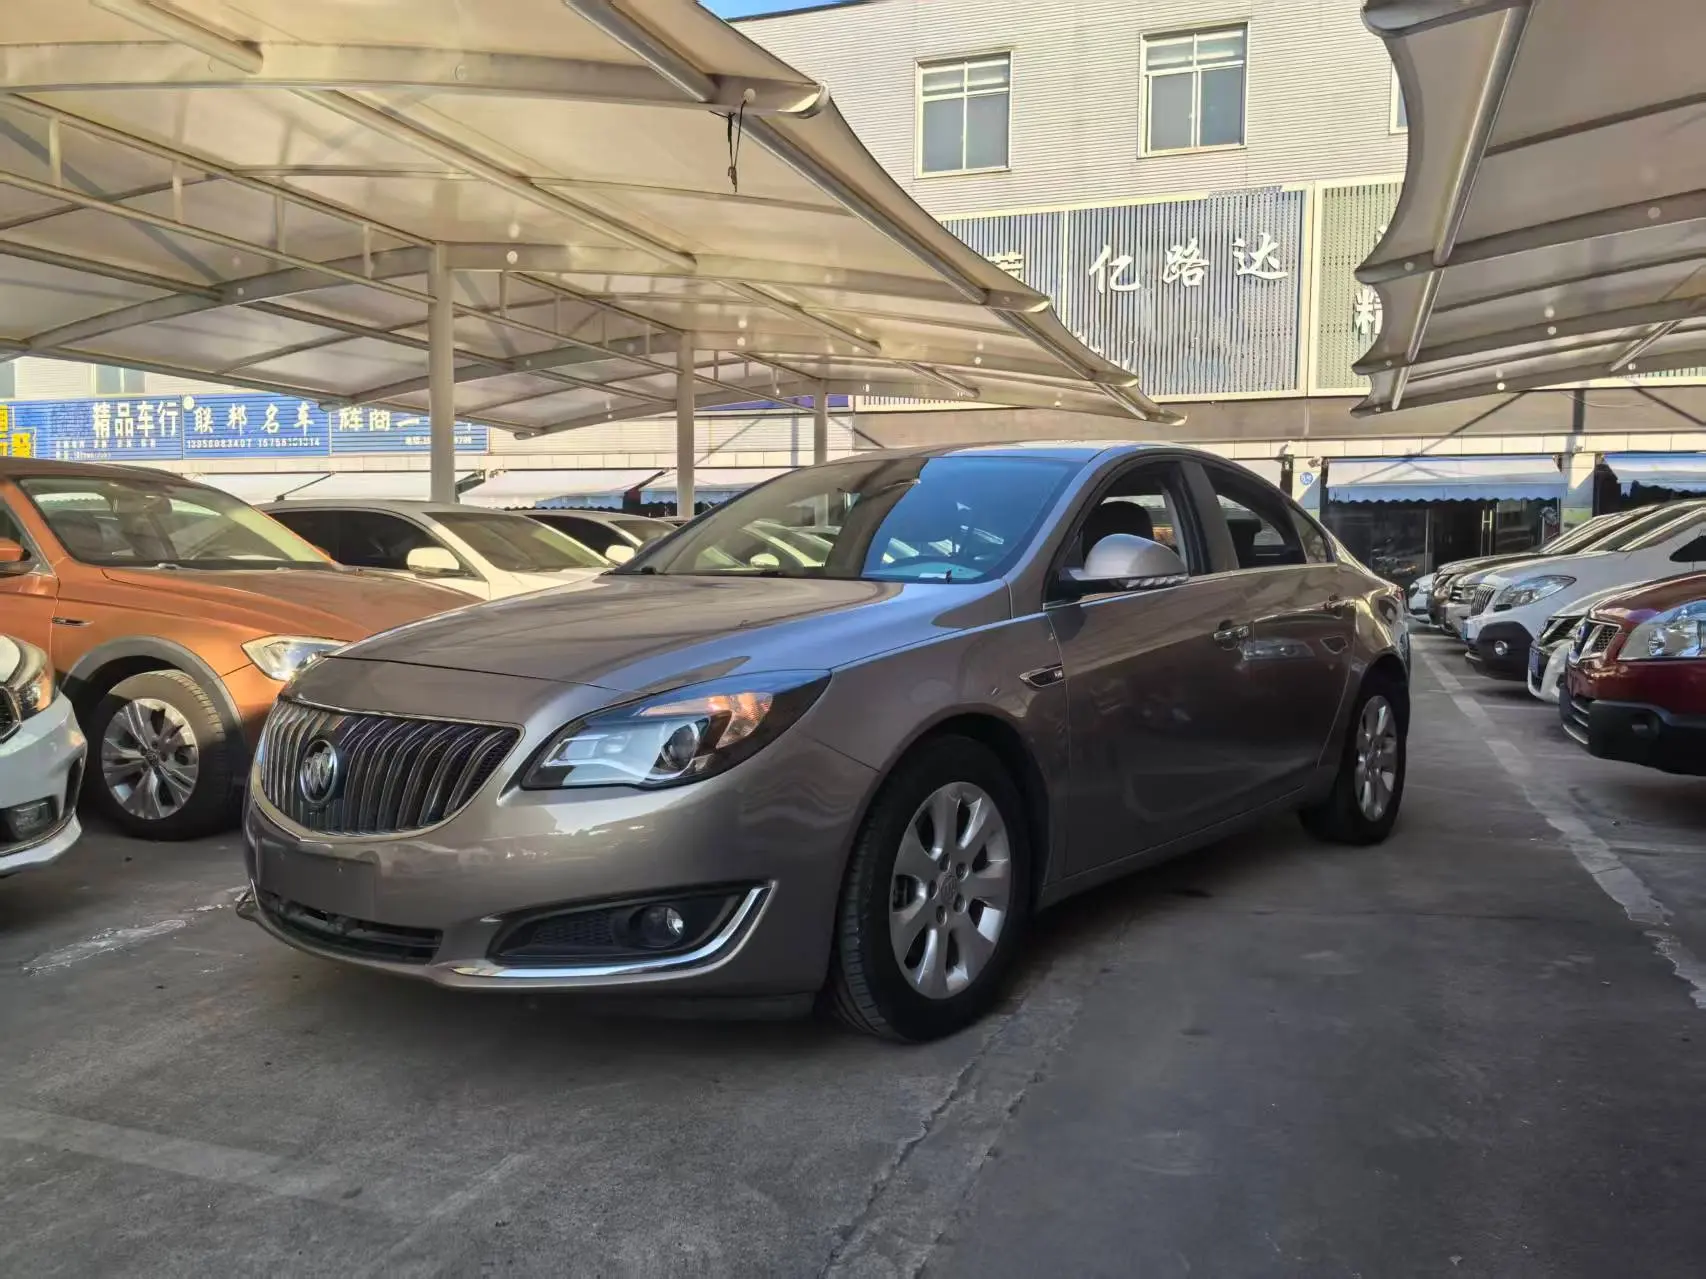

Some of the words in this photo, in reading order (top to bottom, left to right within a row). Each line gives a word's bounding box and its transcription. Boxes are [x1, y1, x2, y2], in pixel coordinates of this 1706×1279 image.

[1089, 232, 1289, 295] 亿路达
[93, 400, 179, 438] 精品车行
[193, 401, 315, 437] 联邦名车
